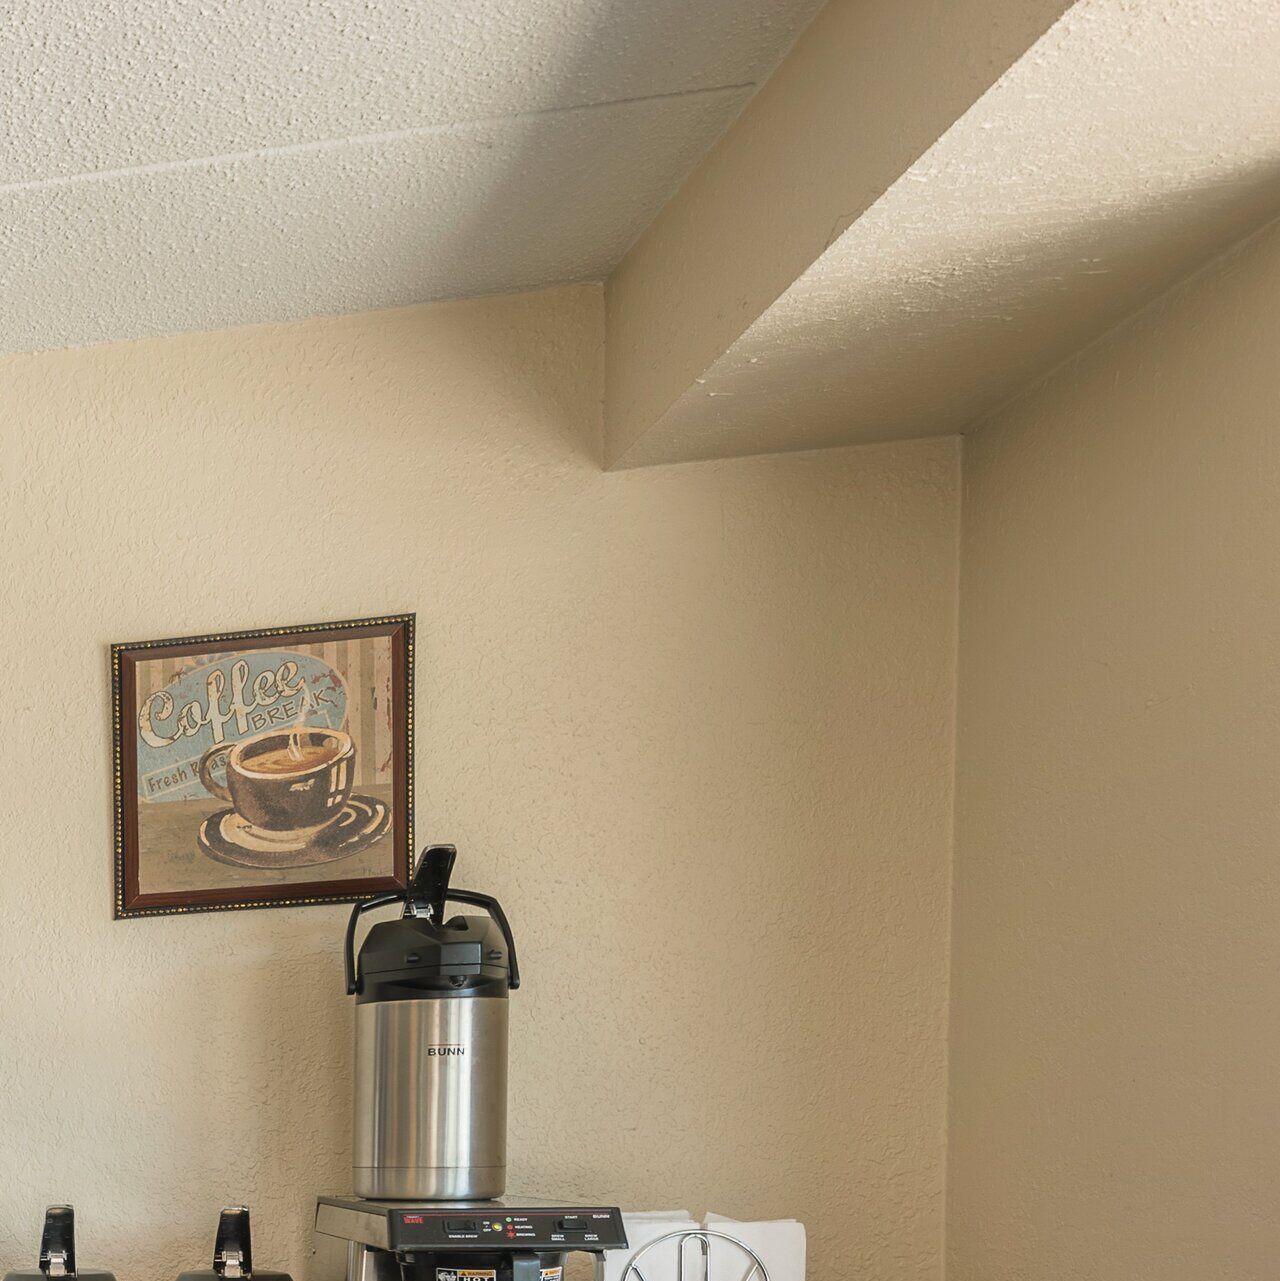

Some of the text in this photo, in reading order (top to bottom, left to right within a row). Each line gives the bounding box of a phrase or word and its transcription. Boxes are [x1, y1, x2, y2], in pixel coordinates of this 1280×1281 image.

[139, 659, 305, 748] Coffee
[251, 688, 328, 731] BREAK
[148, 767, 187, 792] Fresh
[428, 1048, 464, 1056] BUNN
